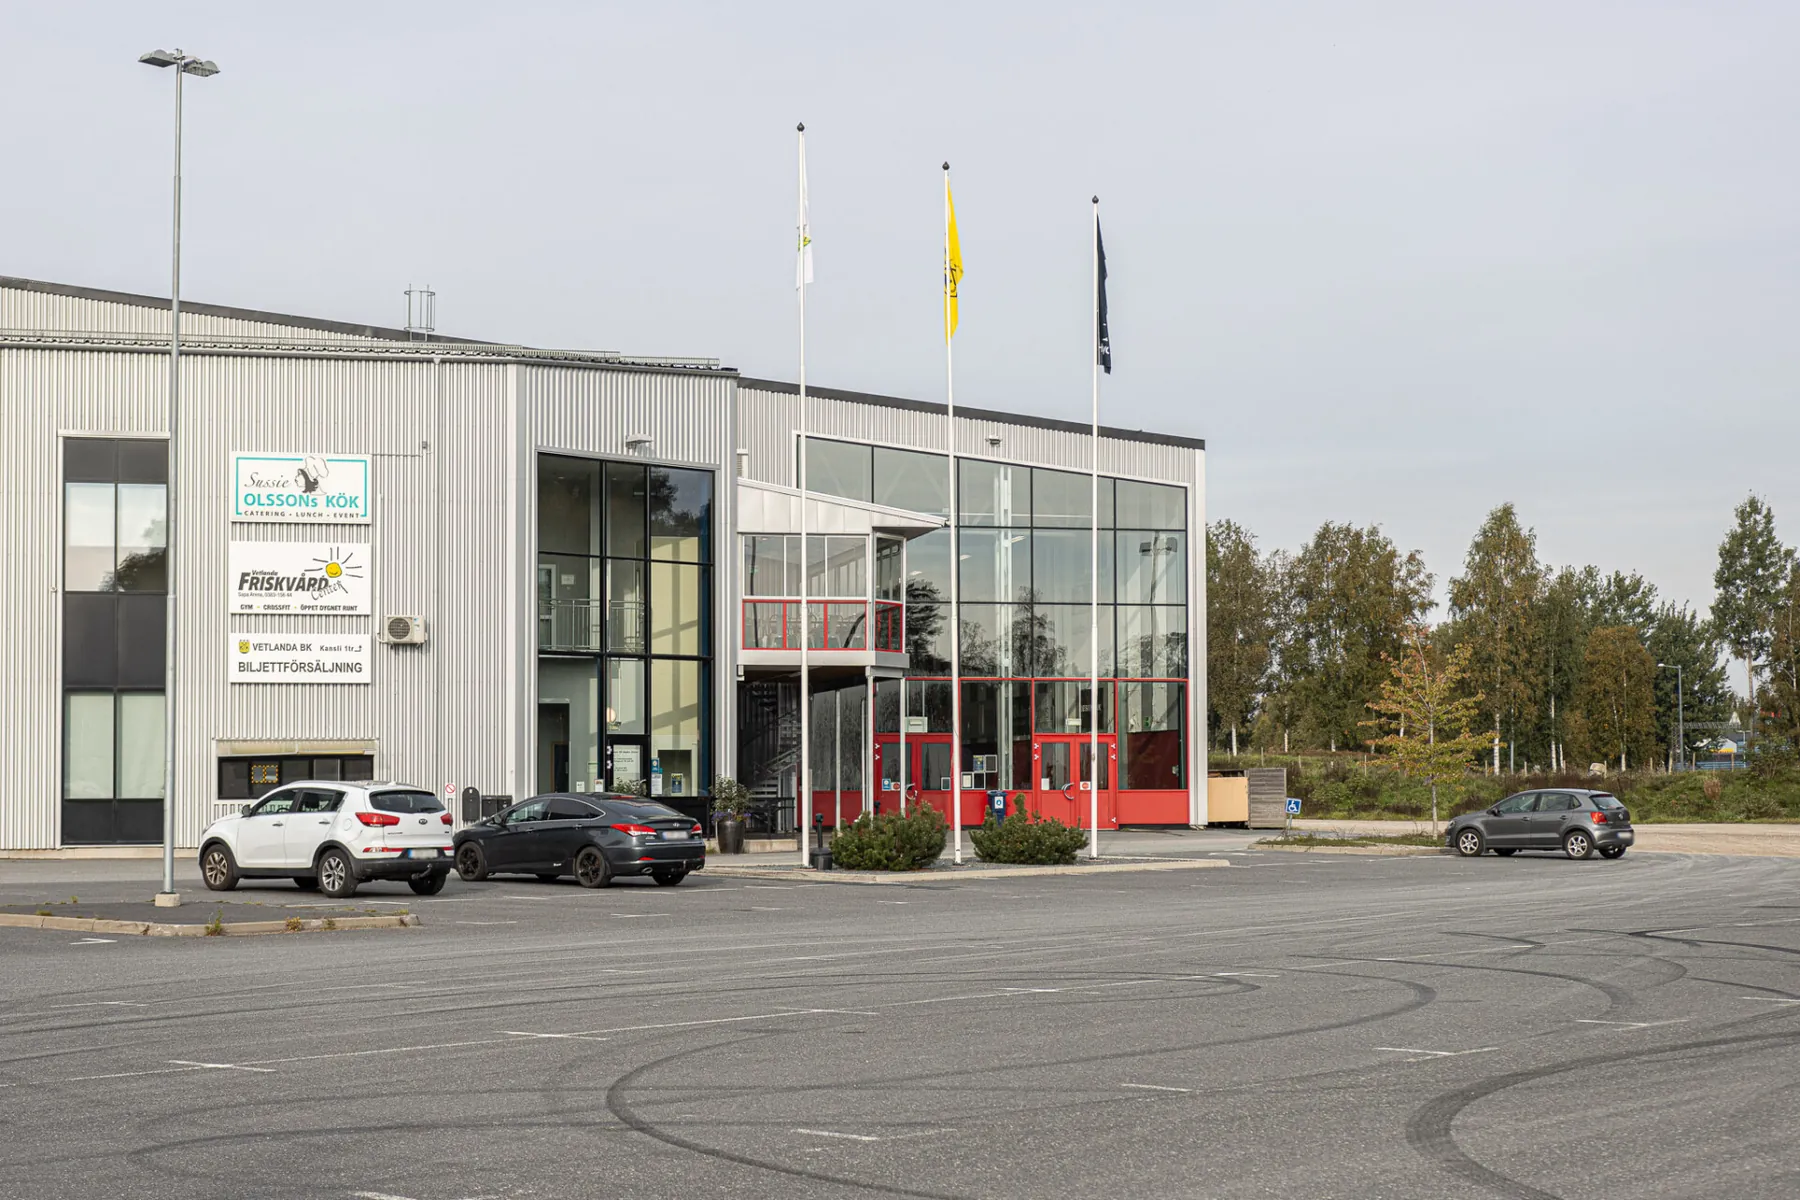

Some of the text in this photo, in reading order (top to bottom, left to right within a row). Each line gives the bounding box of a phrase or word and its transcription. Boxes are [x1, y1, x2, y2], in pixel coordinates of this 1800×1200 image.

[244, 472, 290, 488] Sussie
[244, 492, 359, 508] OLSSONs KÖK
[238, 572, 329, 591] FRISKVÅRD
[253, 643, 298, 652] VETLANDA
[300, 643, 312, 652] BK
[238, 659, 362, 673] BILJETTFÖRSÄLJNING
